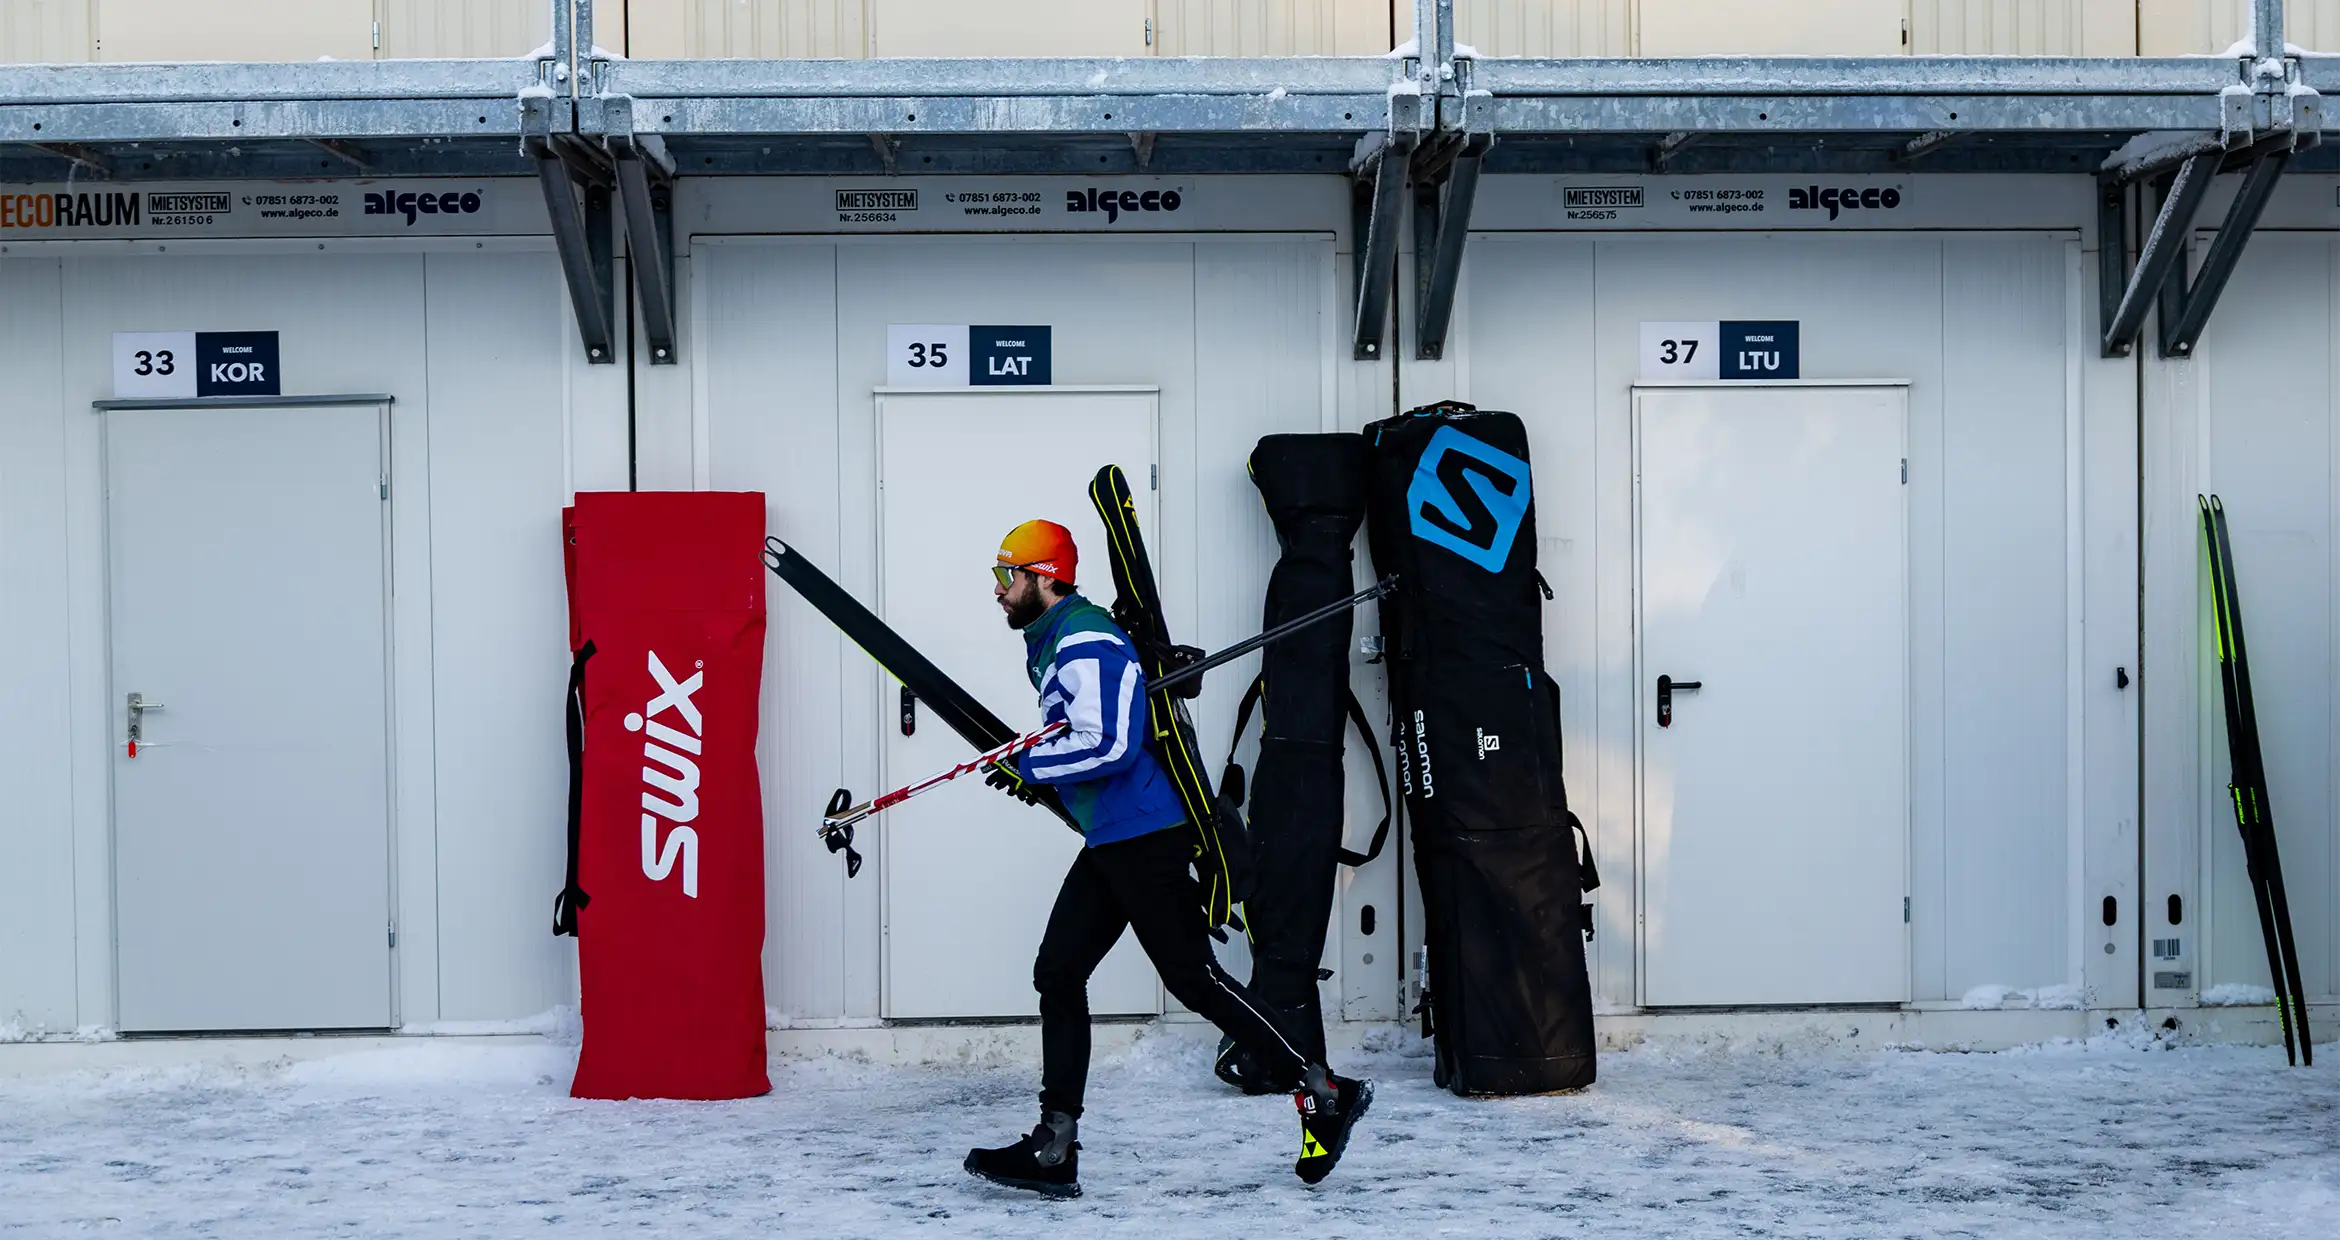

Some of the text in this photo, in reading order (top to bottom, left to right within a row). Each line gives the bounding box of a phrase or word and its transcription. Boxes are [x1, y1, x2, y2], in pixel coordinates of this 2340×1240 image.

[151, 195, 228, 211] MIETSYSTEM
[255, 195, 339, 205] 07851 6873-002
[839, 192, 915, 208] MIETSYSTEM
[958, 192, 1041, 203] 07851 6873-002
[1566, 190, 1641, 206] MIETSYSTEM
[1683, 190, 1764, 200] 07851 6873-002
[1788, 185, 1900, 221] algeco
[1, 193, 140, 227] ECORAUM
[260, 207, 339, 219] www.algeco.de
[364, 189, 481, 227] algeco
[964, 204, 1041, 216] www.algeco.de
[1066, 187, 1182, 224] algeco
[1688, 201, 1764, 213] www.algeco.de
[222, 346, 253, 354] WELCOME
[995, 340, 1026, 348] WELCOME
[1659, 340, 1699, 364] 37
[134, 350, 175, 375] 33
[907, 343, 948, 368] 35
[1739, 352, 1780, 370] LTU
[211, 363, 265, 382] KOR
[989, 357, 1032, 375] LAT
